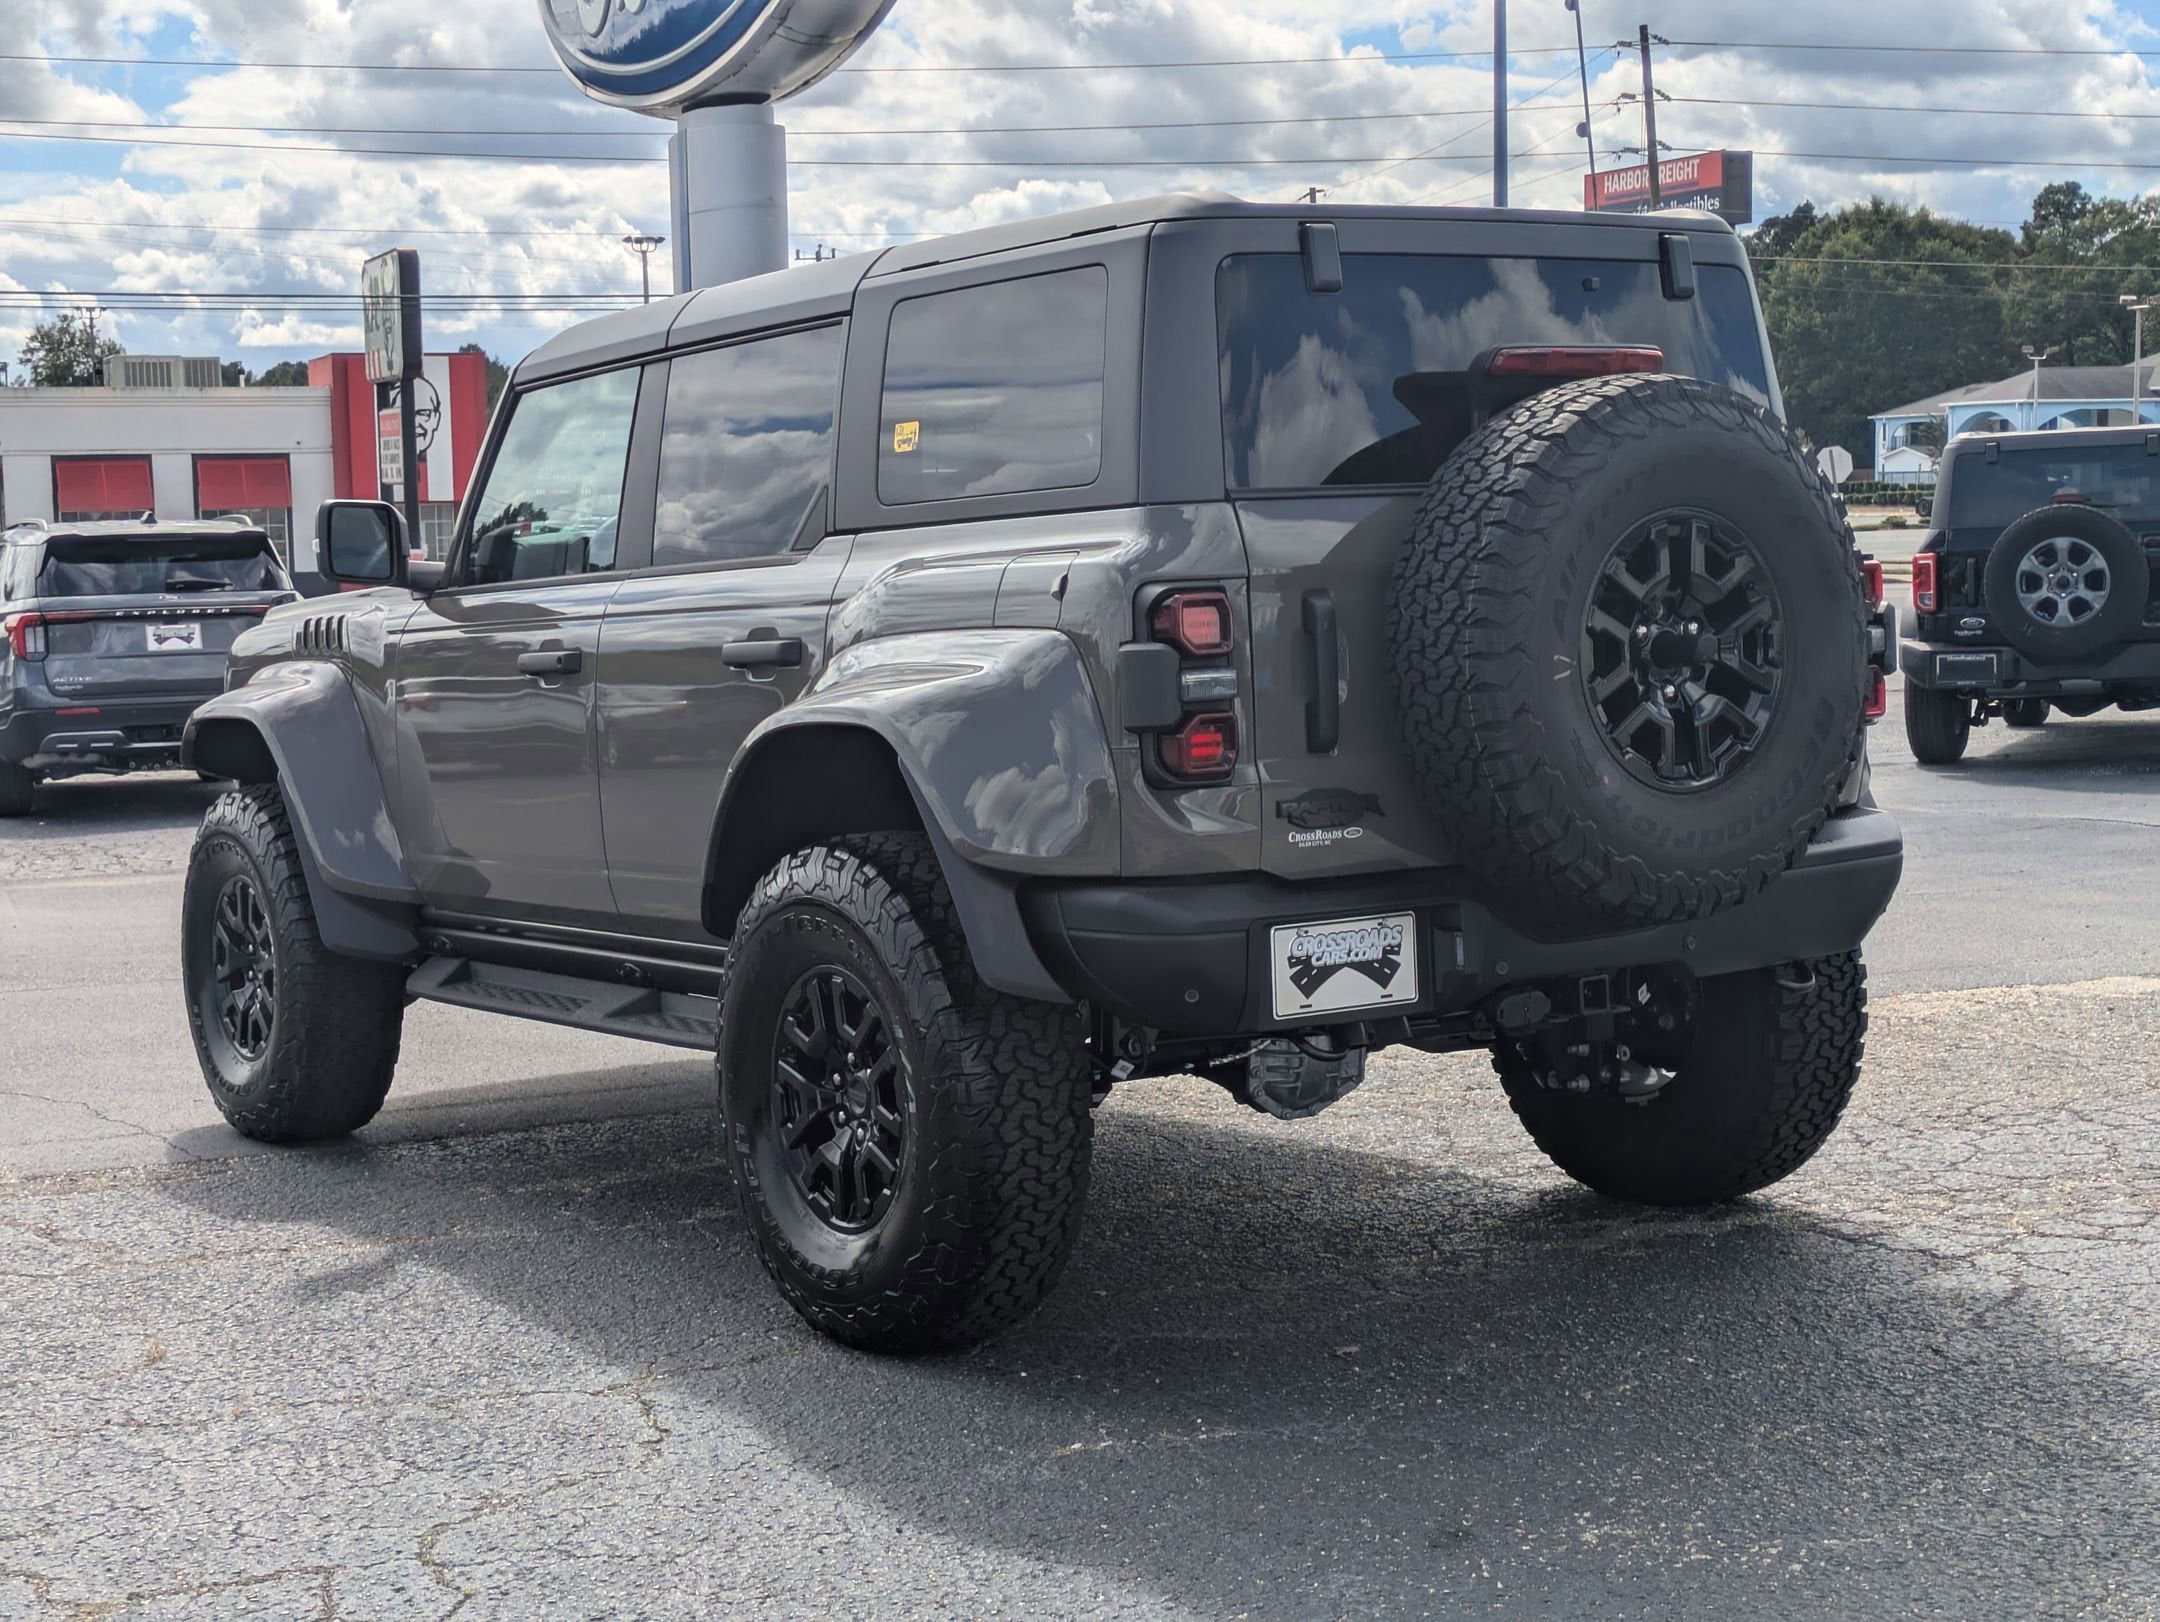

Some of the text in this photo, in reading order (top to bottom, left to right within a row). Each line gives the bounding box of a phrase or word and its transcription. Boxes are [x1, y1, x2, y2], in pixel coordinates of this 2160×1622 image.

[1604, 169, 1649, 194] HARBOR
[1658, 159, 1700, 185] REIGHT
[1656, 194, 1720, 212] lltibles
[115, 607, 231, 617] EXPLORER
[1290, 925, 1403, 957] CROSSROADS
[1311, 945, 1383, 967] CARS.COM
